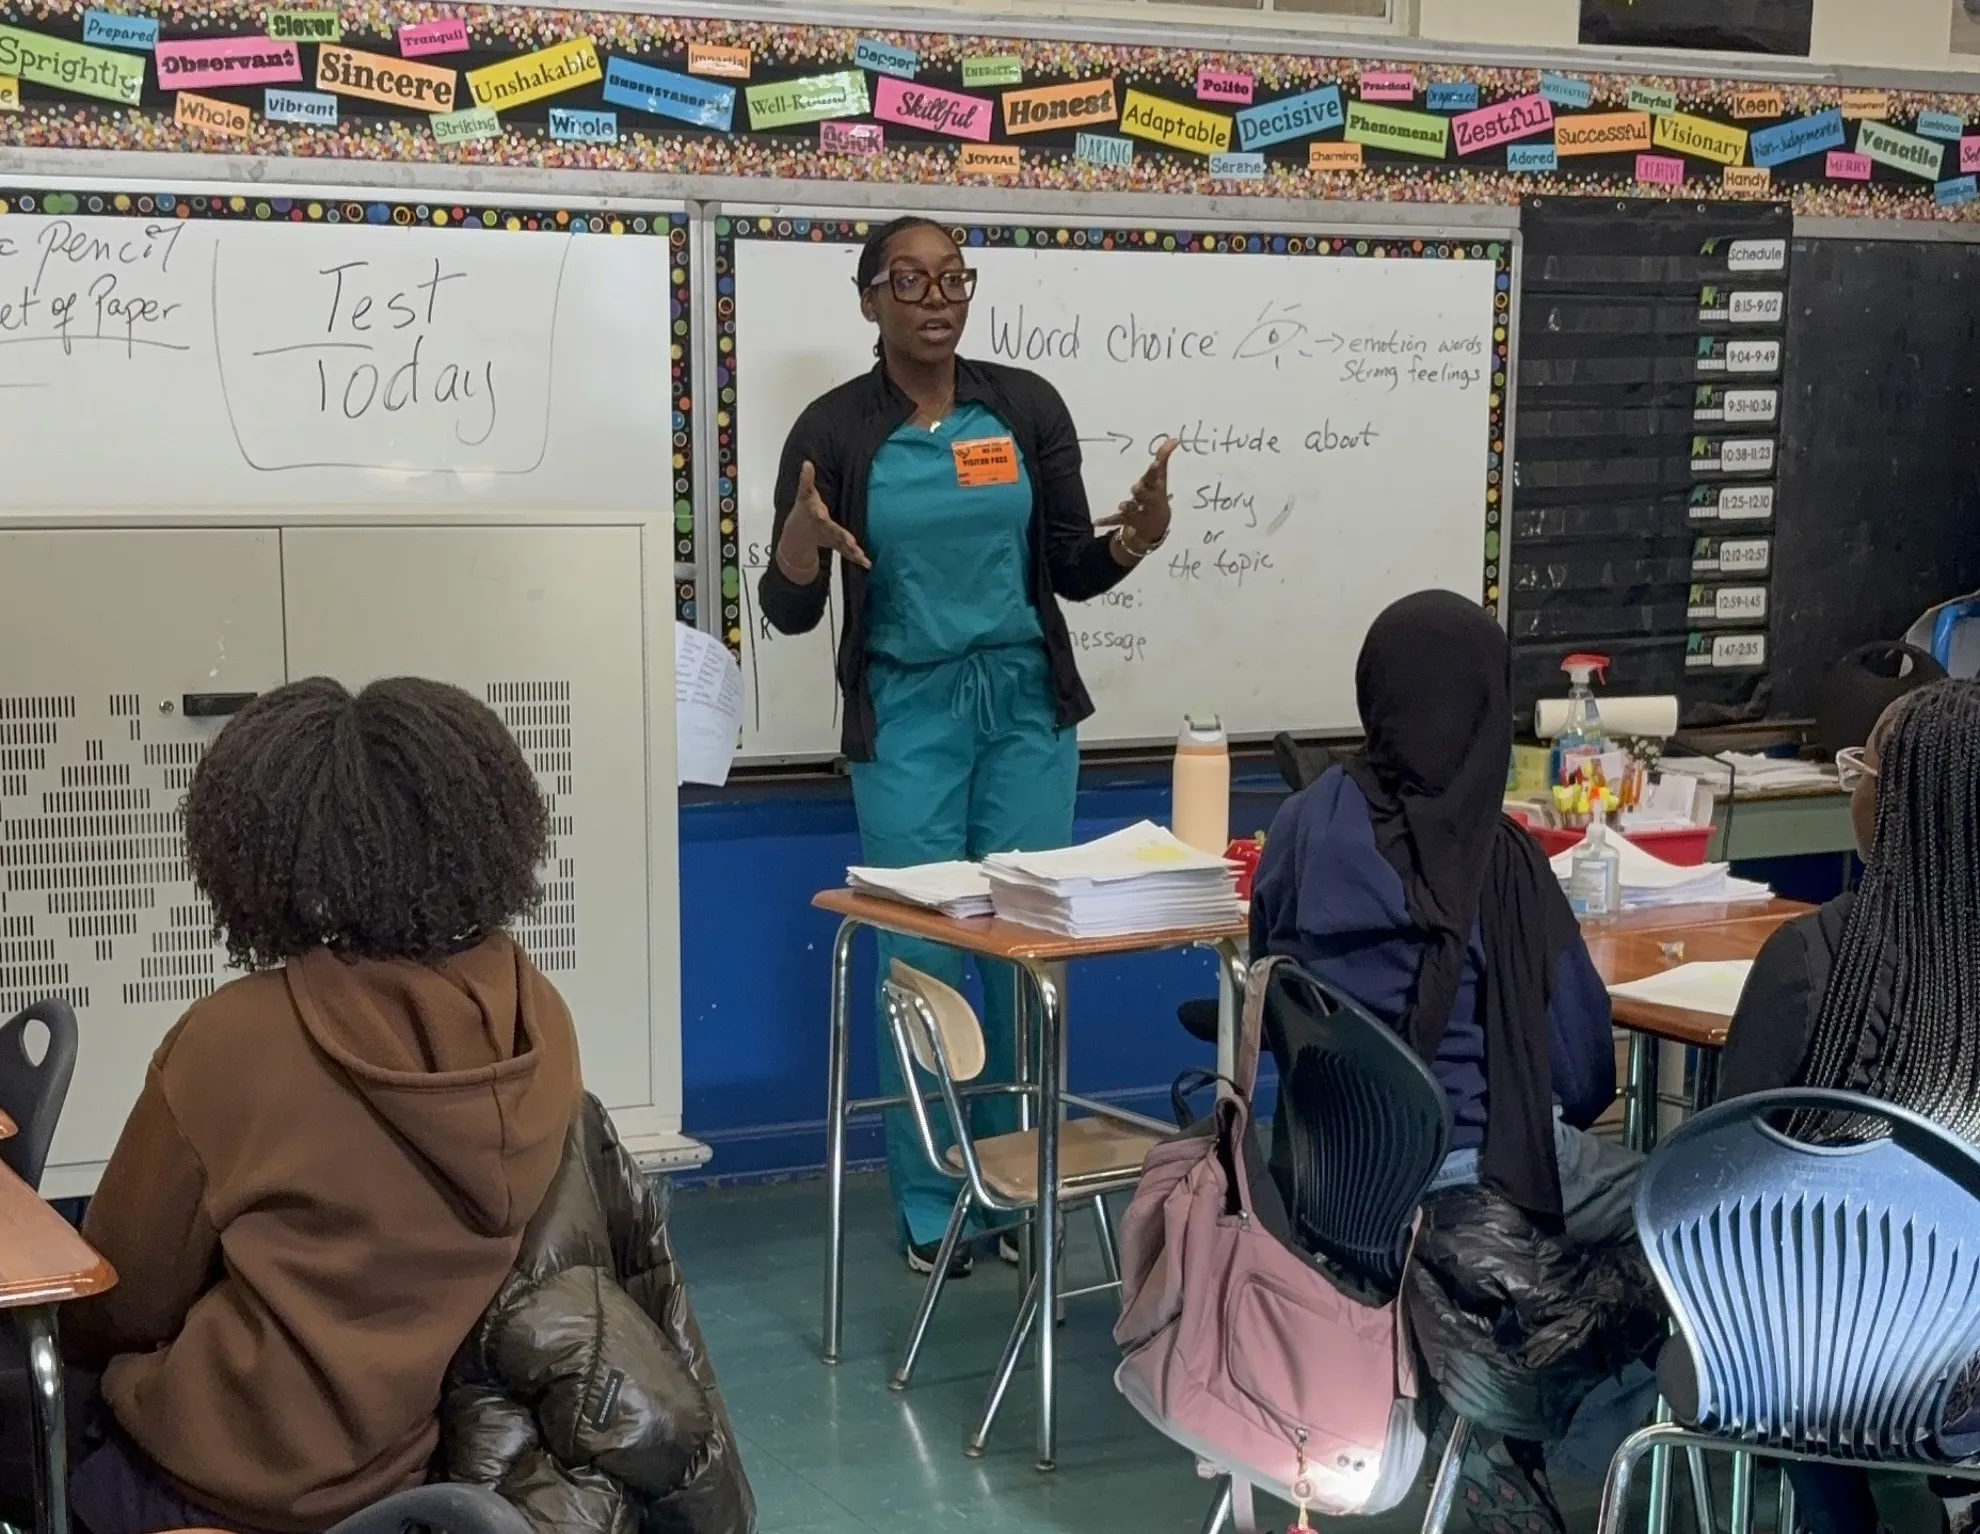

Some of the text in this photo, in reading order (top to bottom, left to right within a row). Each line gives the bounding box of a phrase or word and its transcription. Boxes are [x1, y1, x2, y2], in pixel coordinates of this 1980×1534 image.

[87, 18, 155, 43] Prepared
[273, 15, 334, 37] Clever
[404, 29, 464, 48] Tranquil
[0, 36, 137, 99] Sprightly
[162, 49, 295, 75] Observant
[473, 51, 597, 104] Unshakable
[320, 52, 452, 105] Sincere
[609, 74, 731, 111] UNDERSTAND
[1203, 79, 1249, 95] Polite
[179, 97, 246, 131] Whole
[268, 97, 335, 117] Vibrant
[896, 91, 978, 131] Skillful
[1008, 89, 1112, 126] Honest
[1631, 90, 1673, 108] Playful
[1736, 97, 1778, 114] Keen
[434, 115, 496, 138] Striking
[1125, 104, 1227, 148] Adaptable
[1240, 99, 1339, 142] Decisive
[1350, 113, 1444, 144] Phenomenal
[1457, 101, 1550, 147] Zestful
[1558, 120, 1647, 145] Successful
[1078, 135, 1132, 166] DARING
[1660, 118, 1742, 165] Visionary
[1862, 128, 1938, 169] Versatile
[1210, 157, 1261, 174] Serene
[1311, 151, 1359, 164] Charming
[1509, 150, 1554, 165] Adored
[1726, 173, 1768, 193] Handy
[1729, 247, 1782, 262] Schedule
[320, 258, 467, 332] Test
[52, 292, 77, 356] of
[88, 273, 183, 359] Paper
[991, 304, 1081, 360] Word
[1349, 329, 1482, 356] emotion words
[1407, 354, 1481, 390] feelings
[253, 335, 496, 446] Today
[1304, 418, 1381, 453] about
[1203, 529, 1225, 545] or
[1168, 549, 1201, 581] the
[1101, 588, 1143, 610] one:
